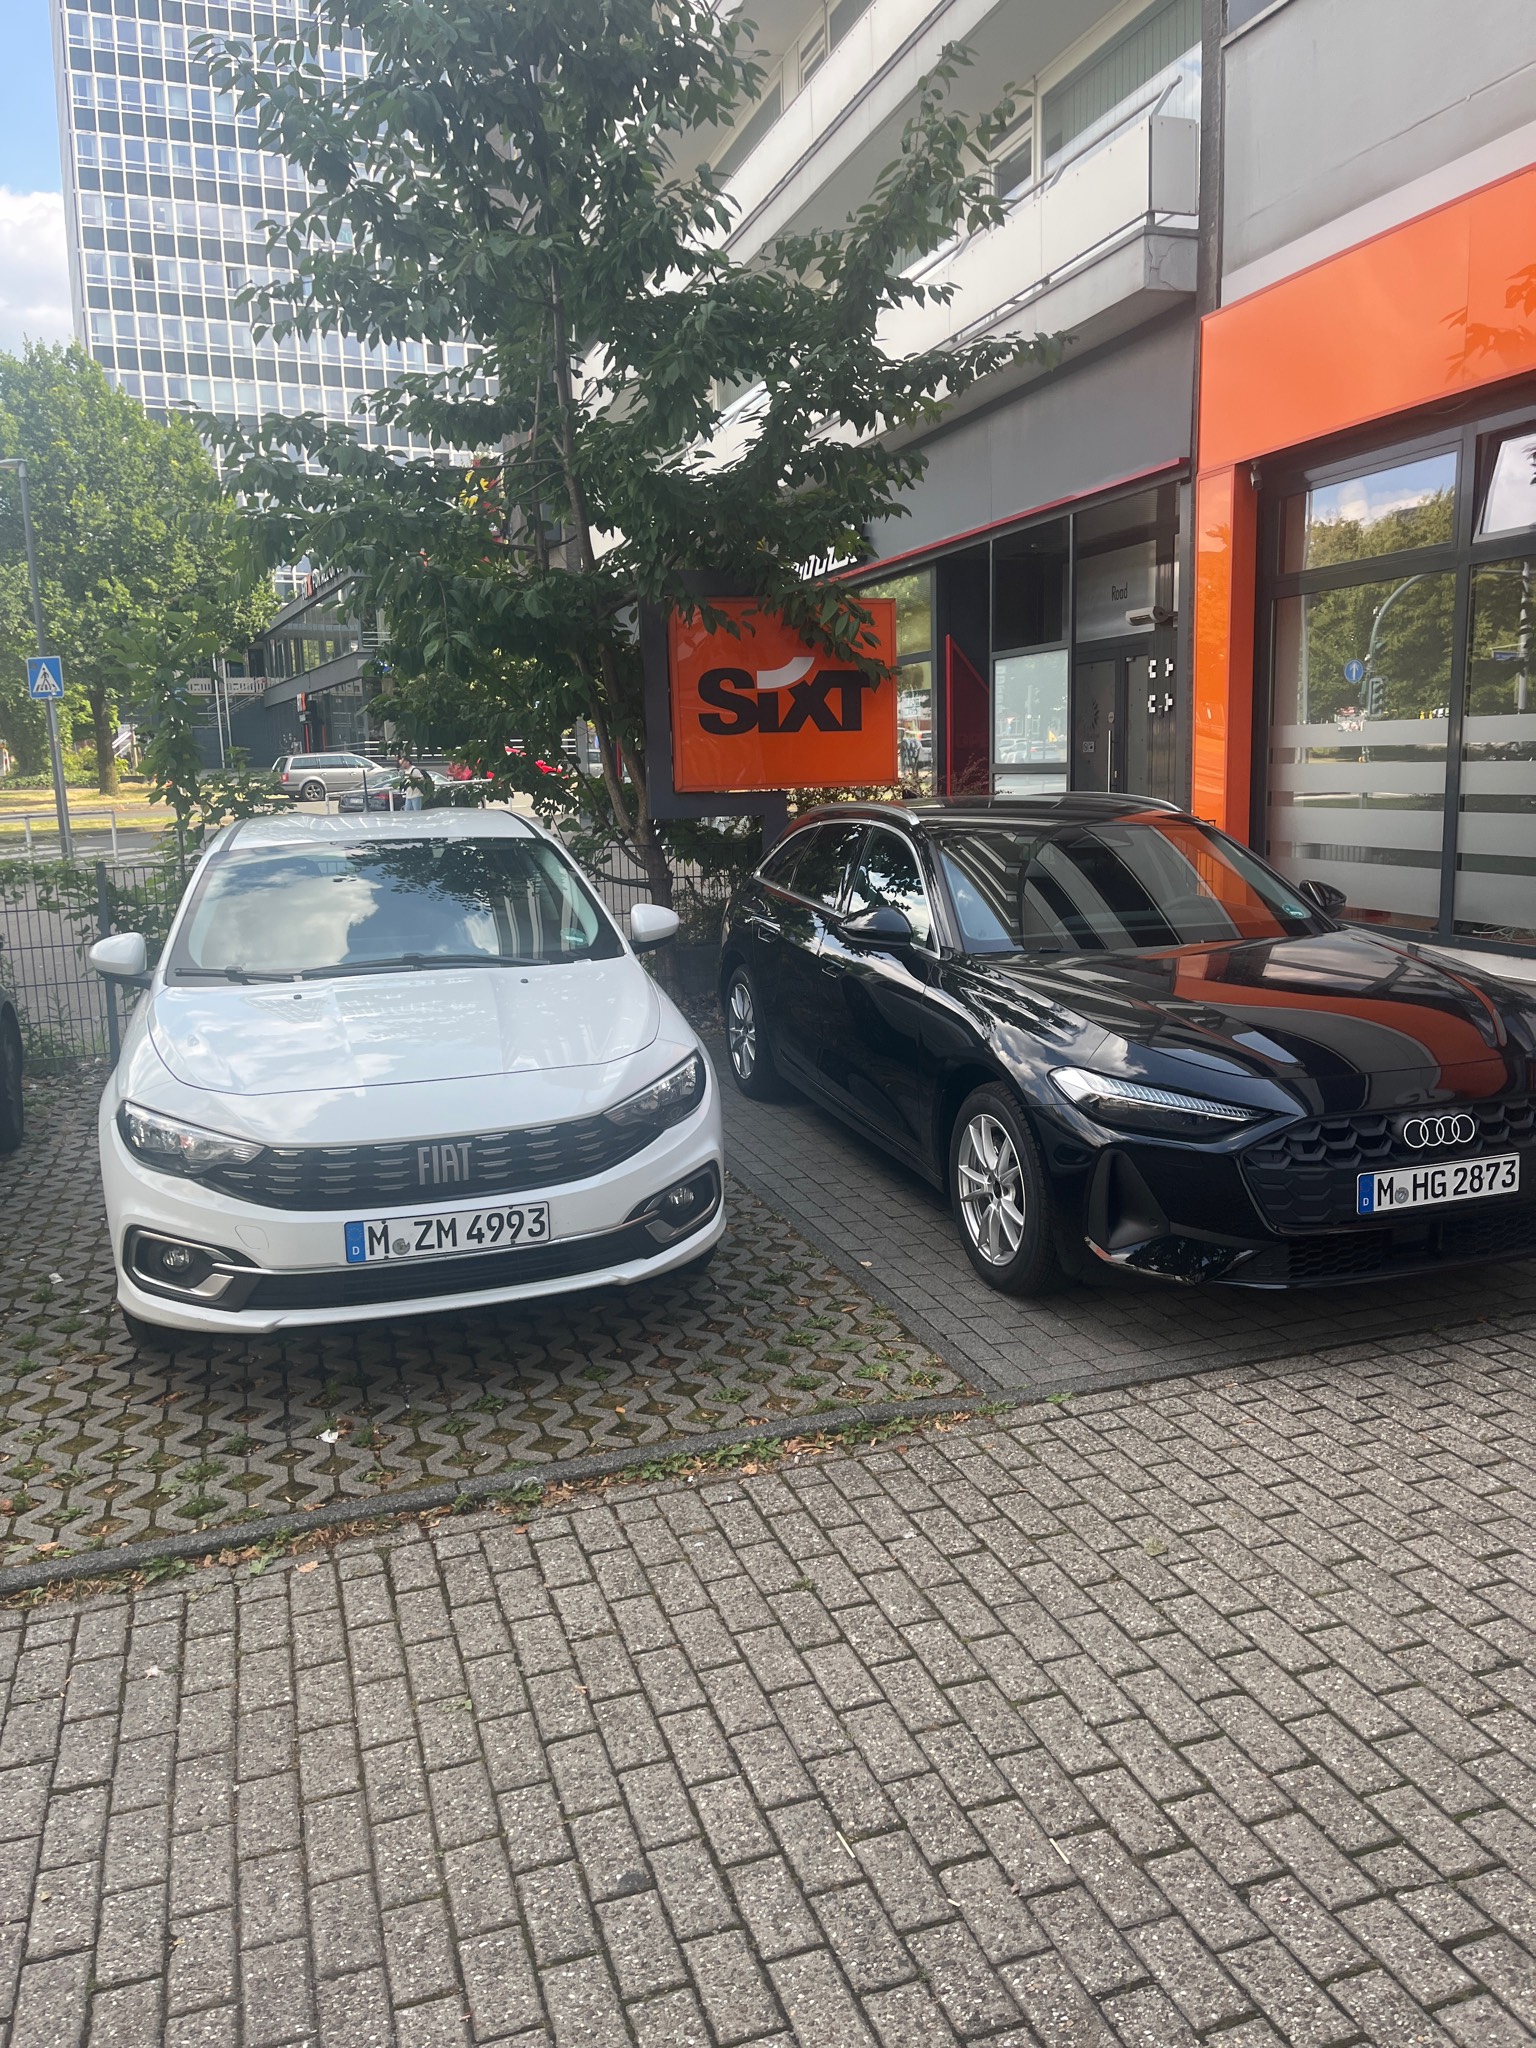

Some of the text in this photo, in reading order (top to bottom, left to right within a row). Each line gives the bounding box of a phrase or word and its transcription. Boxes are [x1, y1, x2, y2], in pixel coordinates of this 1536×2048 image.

[417, 1142, 472, 1185] FIAT
[1377, 1160, 1516, 1206] M HG 2873
[1362, 1198, 1370, 1206] D
[352, 1246, 360, 1255] D
[367, 1207, 546, 1255] M ZM 4993
